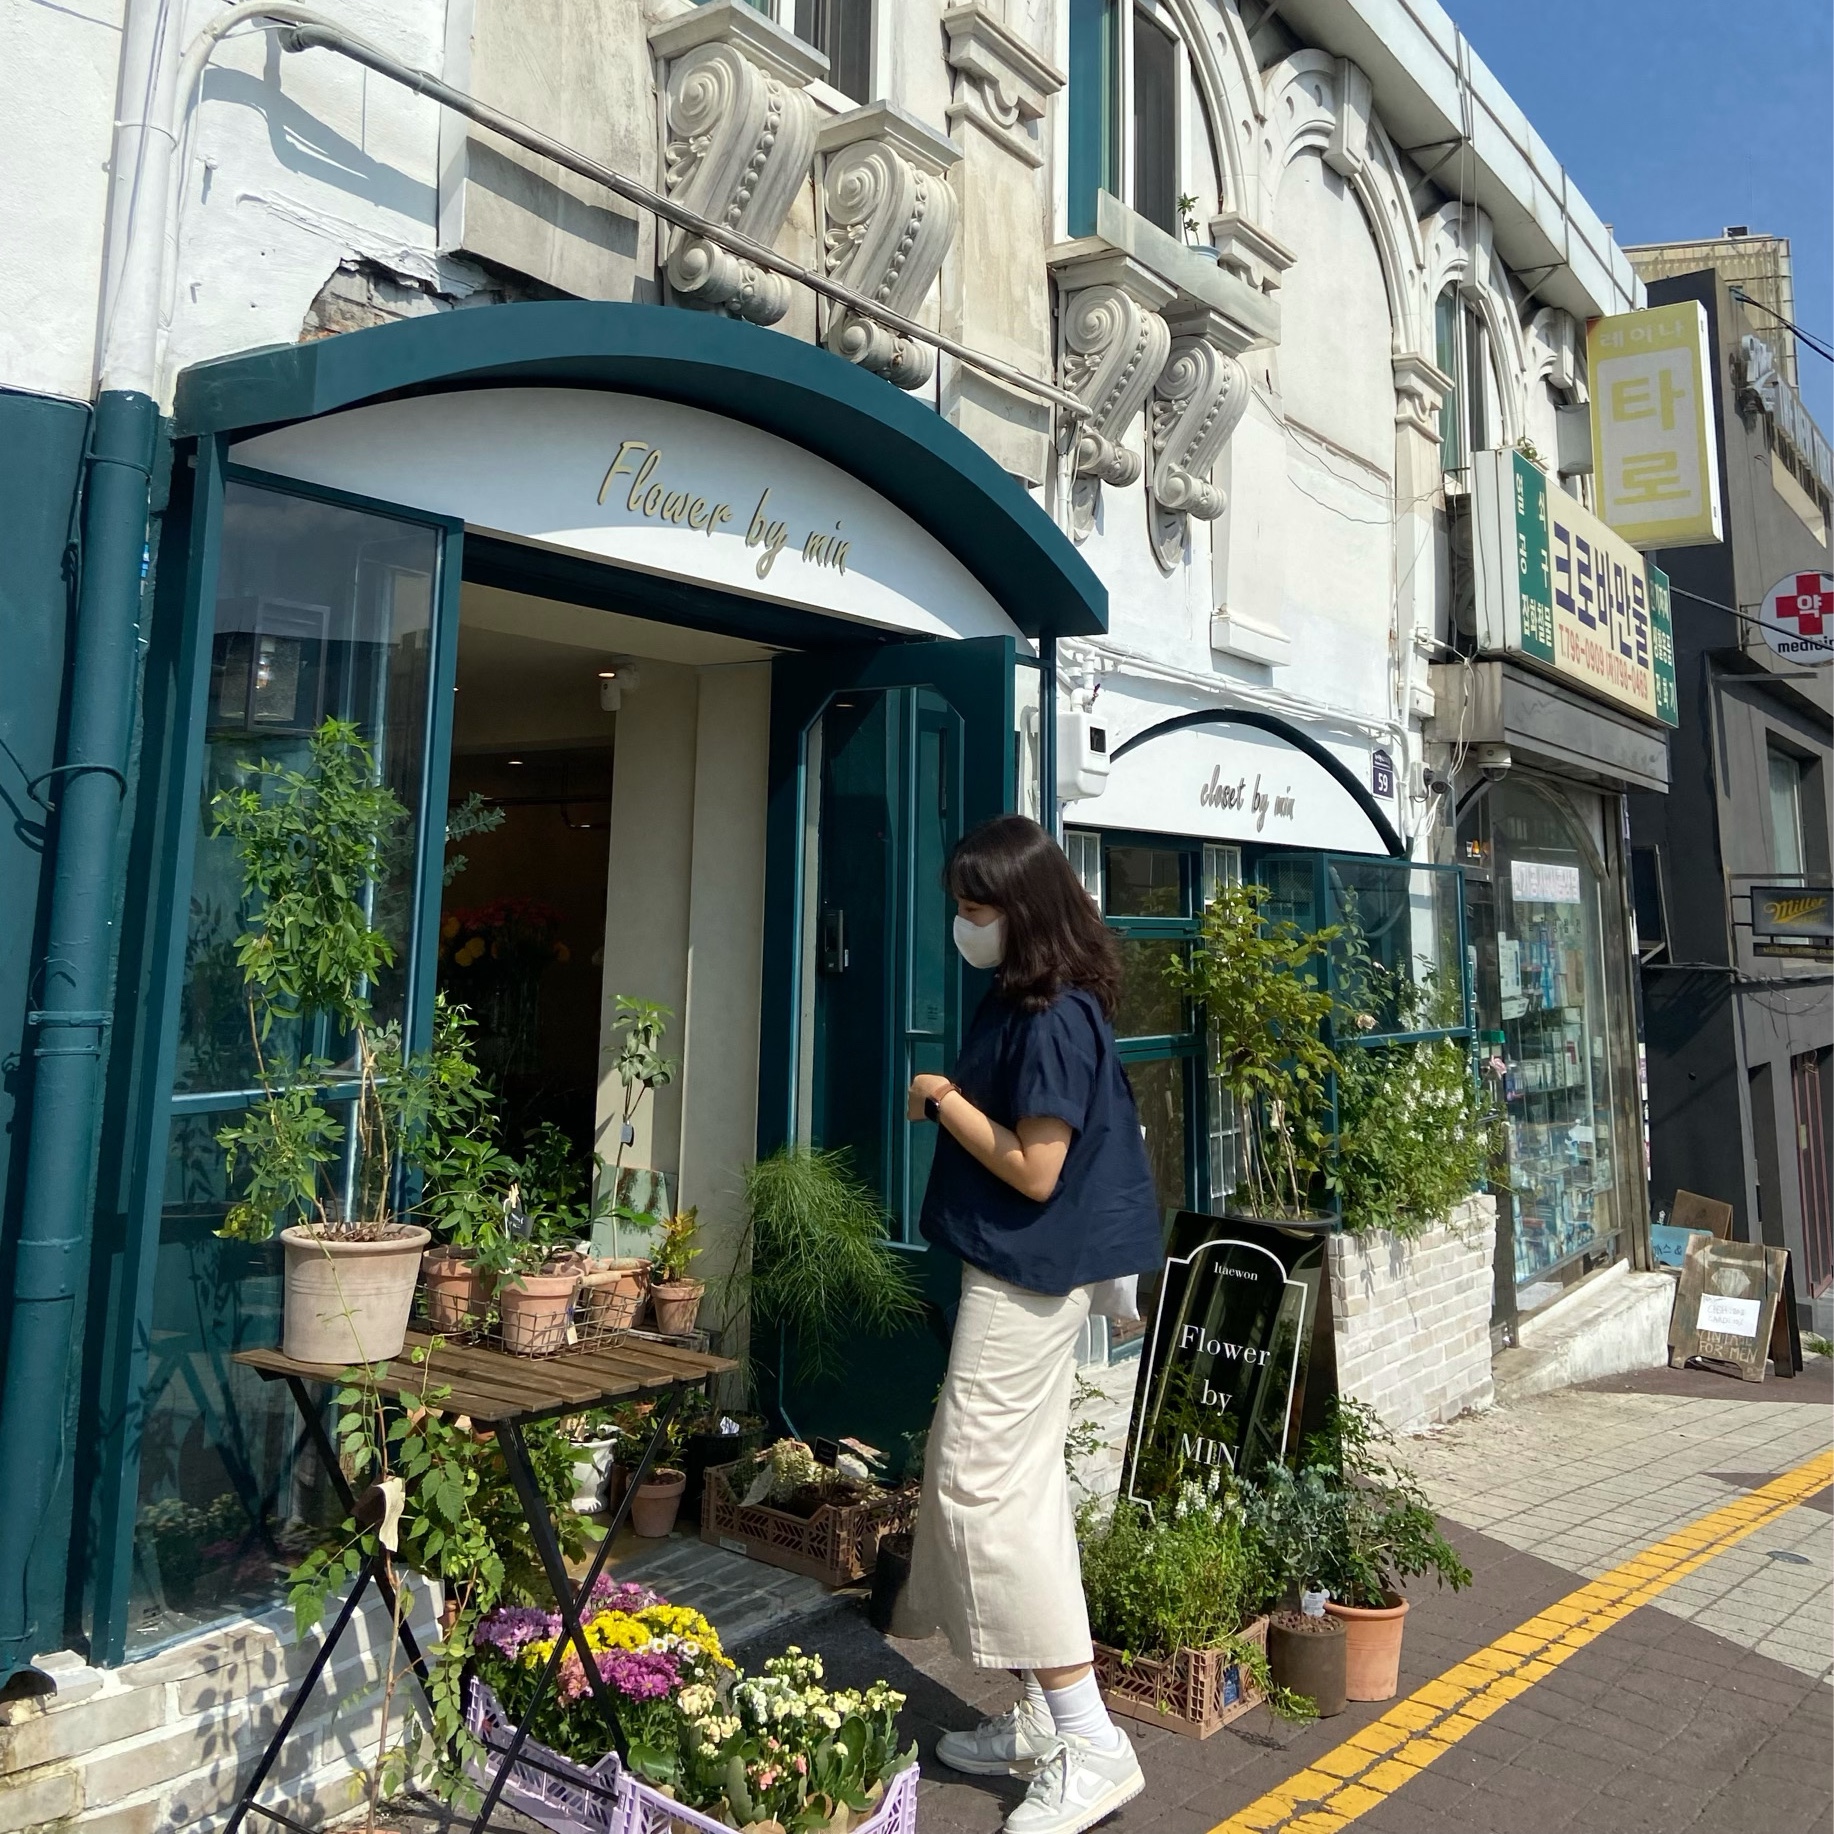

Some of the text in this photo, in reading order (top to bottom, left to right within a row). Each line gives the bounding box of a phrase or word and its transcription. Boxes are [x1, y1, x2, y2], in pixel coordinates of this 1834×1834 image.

[1611, 367, 1691, 507] 타로
[597, 440, 850, 580] Flower by min
[1554, 520, 1649, 671] 크로바만물
[1797, 594, 1822, 618] 약
[1200, 764, 1295, 833] closet by min
[1378, 772, 1388, 793] 59
[1763, 896, 1828, 924] Miller
[1213, 1261, 1258, 1281] Itaewon
[1178, 1324, 1271, 1367] Flower
[1699, 1340, 1759, 1364] FOR MEN
[1200, 1379, 1233, 1416] by
[1180, 1432, 1240, 1472] MIN
